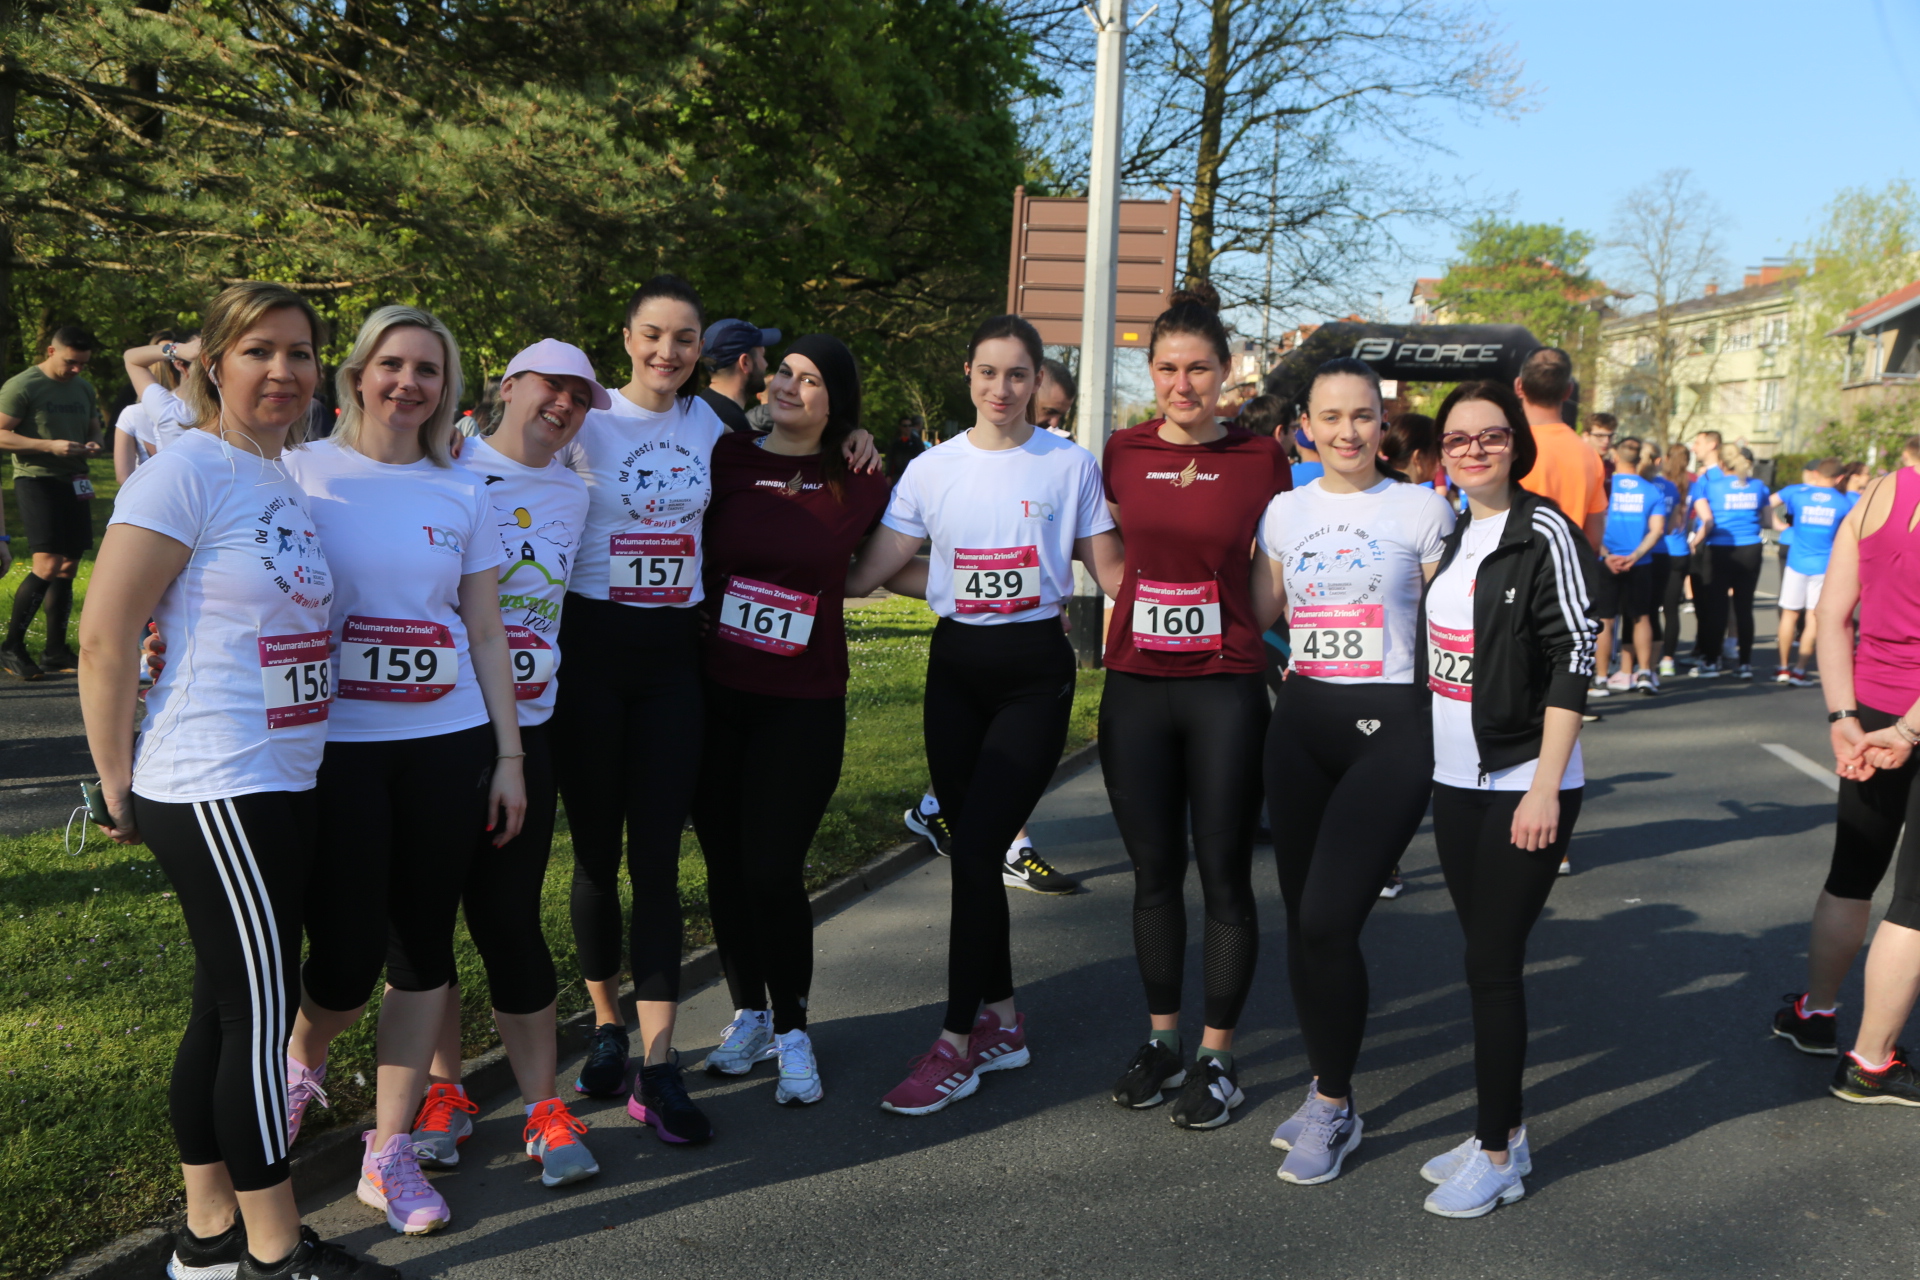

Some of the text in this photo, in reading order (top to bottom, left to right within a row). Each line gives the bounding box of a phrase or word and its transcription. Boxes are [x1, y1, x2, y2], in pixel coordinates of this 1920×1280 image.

[1395, 343, 1503, 362] FORCE
[622, 440, 654, 468] bolesti
[659, 439, 670, 449] mi
[675, 444, 690, 457] smo
[755, 479, 824, 490] ZRINSKI HALF
[1146, 471, 1220, 481] ZRINSKI HALF
[258, 495, 286, 525] bolesti
[621, 493, 632, 506] jer
[628, 508, 641, 520] nas
[640, 517, 677, 528] zdravlje
[680, 508, 702, 524] dobro
[615, 538, 681, 546] Polumaraton Zrinski
[956, 551, 1018, 560] Polumaraton Zrinski
[1294, 524, 1331, 552] bolesti
[1337, 523, 1351, 532] mi
[1354, 528, 1369, 540] smo
[1367, 539, 1386, 561] brži
[261, 556, 277, 571] jer
[273, 575, 291, 593] nas
[290, 591, 320, 609] zdravlje
[628, 557, 684, 586] 157
[965, 570, 1023, 599] 439
[1368, 573, 1383, 592] drži
[732, 580, 797, 602] Polumaraton Zrinski
[1139, 584, 1201, 596] Polumaraton Zrinski
[348, 621, 433, 635] Polumaraton Zrinski
[738, 603, 792, 639] 161
[1147, 605, 1204, 636] 160
[1294, 609, 1360, 618] Polumaraton Zrinski
[266, 640, 311, 652] Polumaraton
[1303, 629, 1364, 659] 438
[362, 646, 438, 683] 159
[514, 650, 536, 682] 9
[1434, 648, 1473, 684] 222
[284, 662, 329, 703] 158
